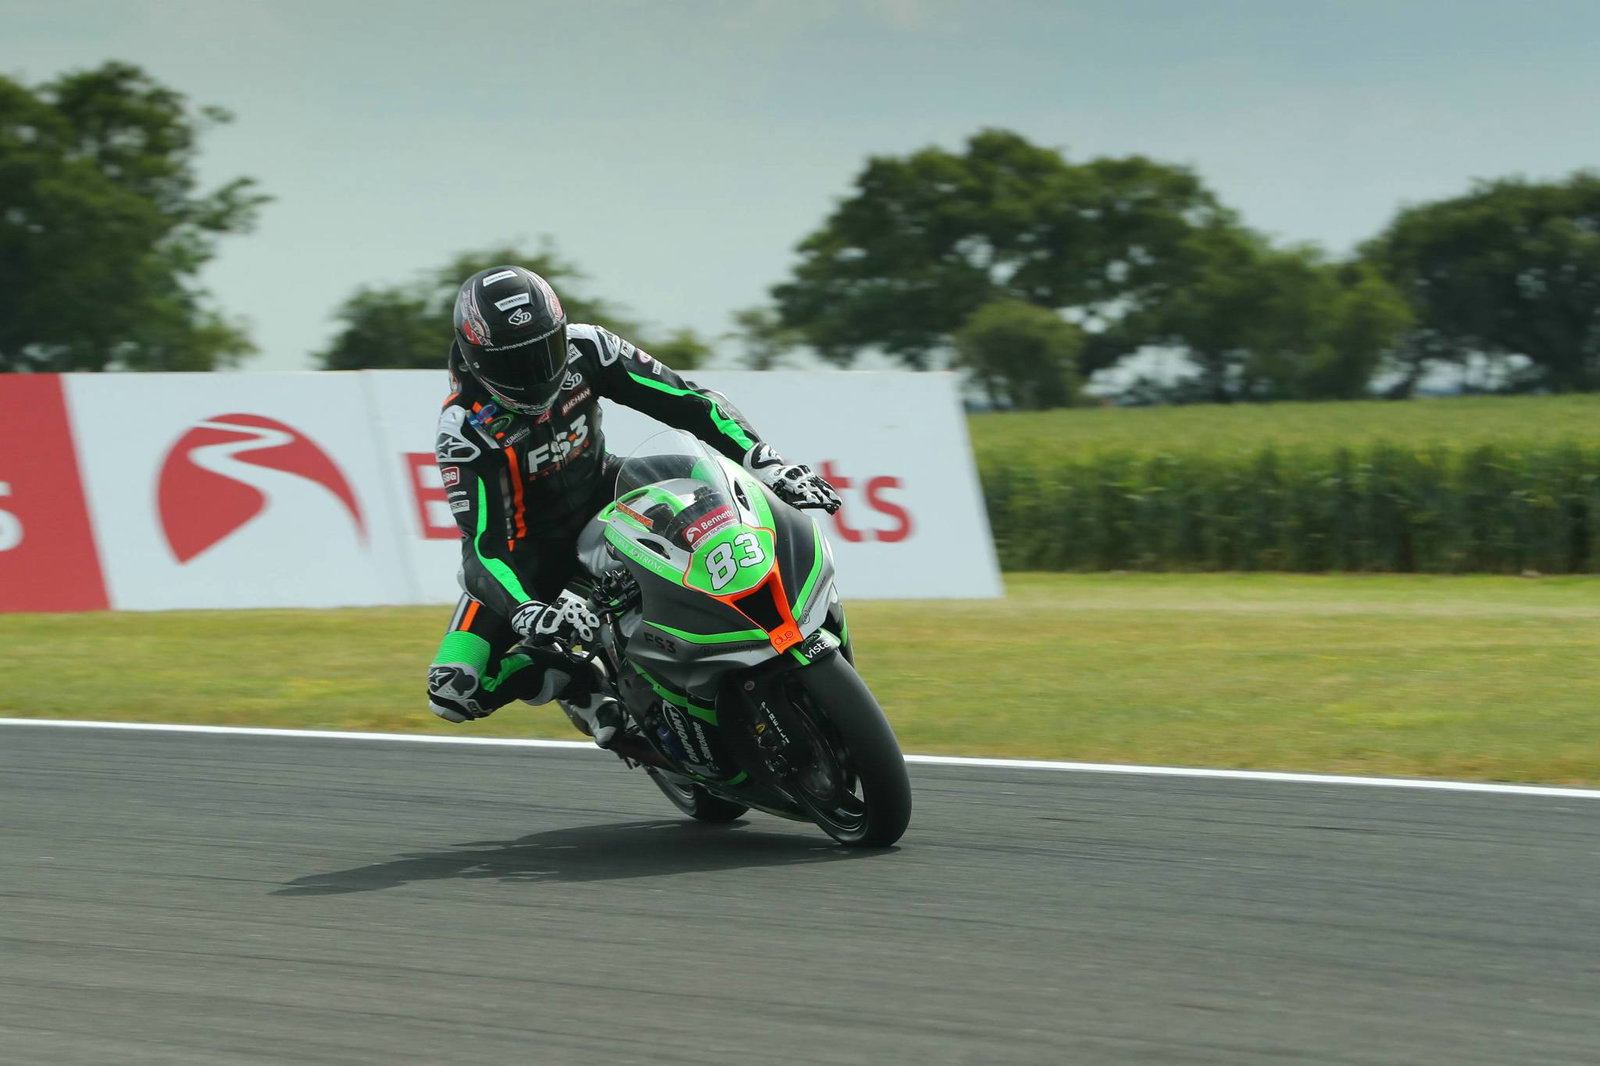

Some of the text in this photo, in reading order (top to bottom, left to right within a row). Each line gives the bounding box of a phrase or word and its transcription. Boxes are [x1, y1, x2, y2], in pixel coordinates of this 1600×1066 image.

[562, 387, 592, 414] BUCHAN
[701, 509, 734, 530] Bennetts
[705, 532, 766, 591] 83
[805, 641, 830, 659] vista
